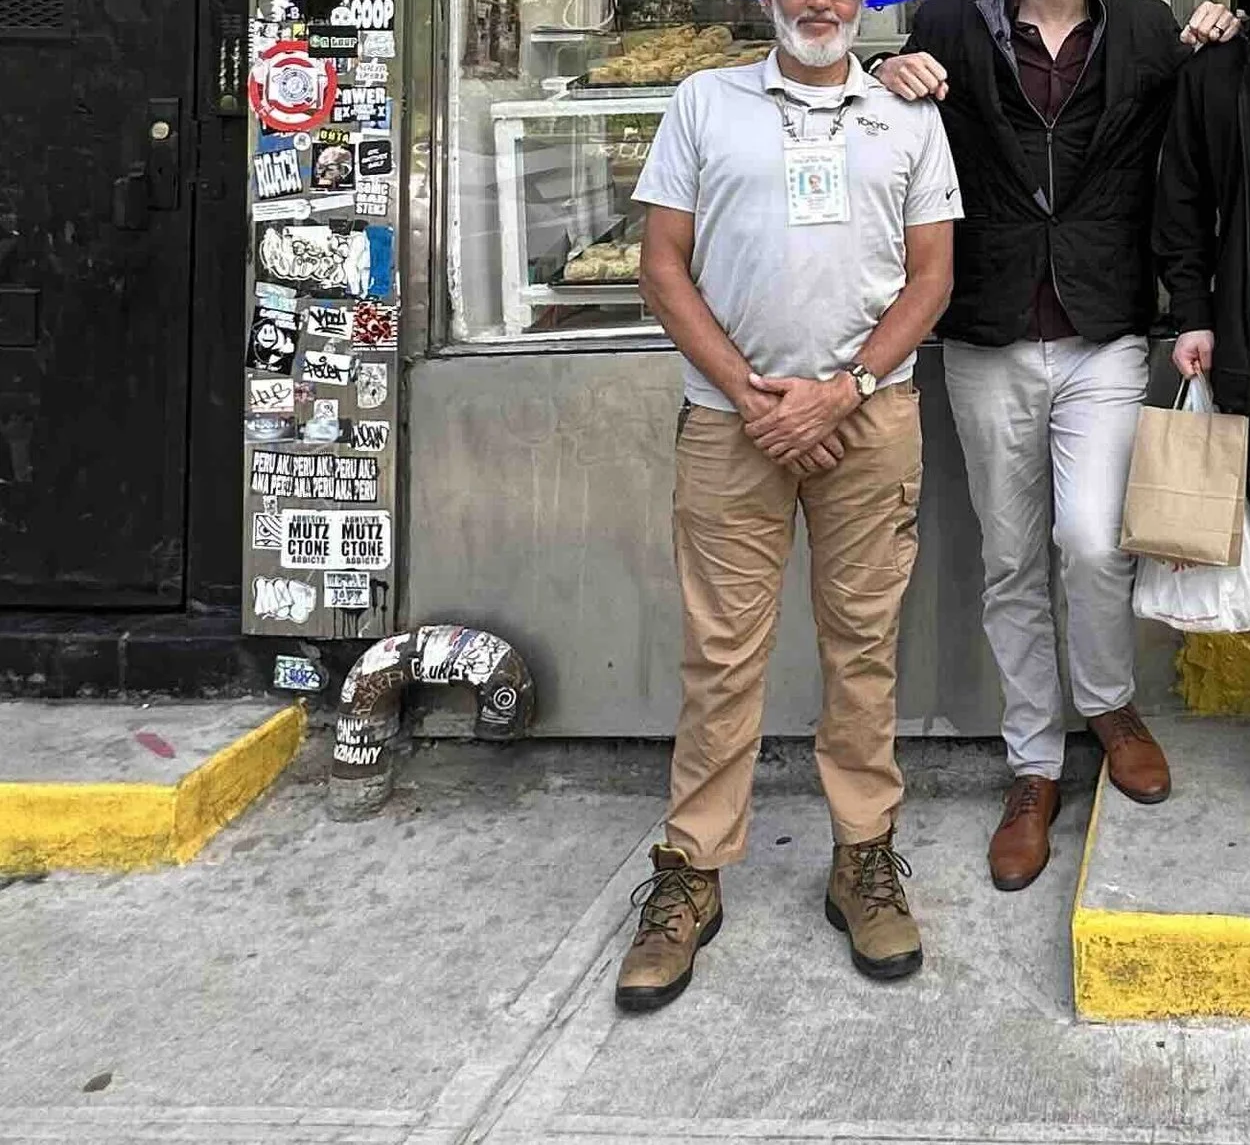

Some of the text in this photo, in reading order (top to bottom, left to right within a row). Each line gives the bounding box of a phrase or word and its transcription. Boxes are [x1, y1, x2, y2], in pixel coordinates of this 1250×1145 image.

[288, 523, 329, 539] MUTZ
[341, 523, 383, 540] MUTZ
[287, 539, 330, 556] CTONE
[341, 540, 384, 557] CTONE
